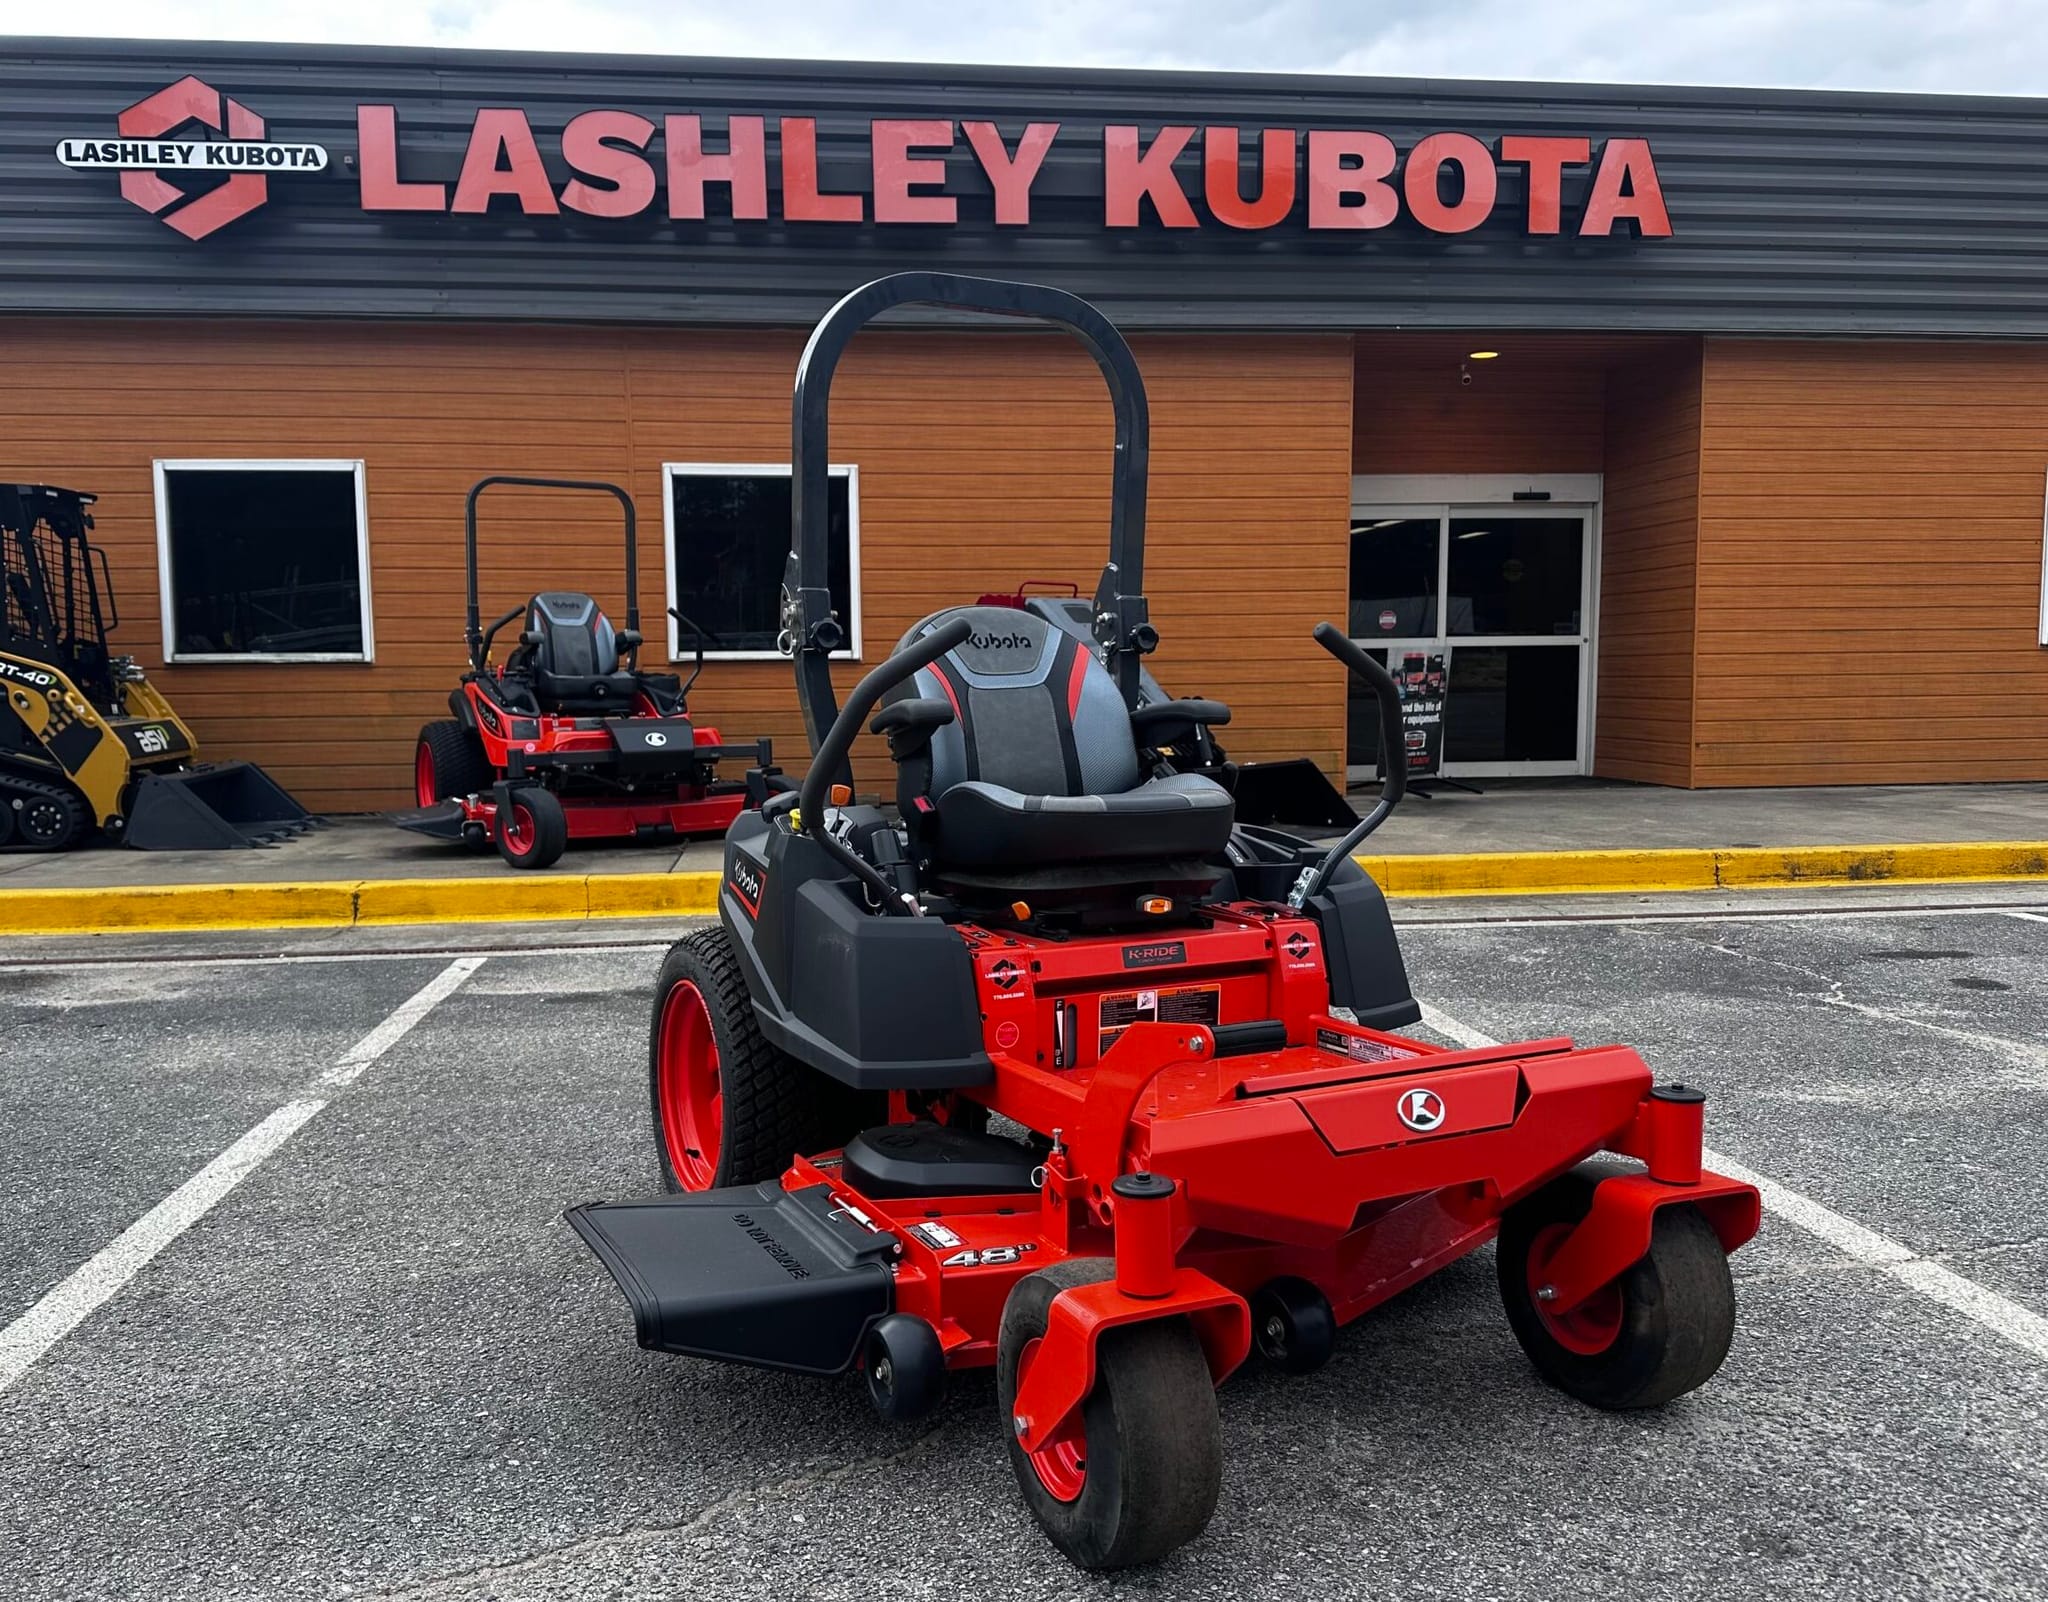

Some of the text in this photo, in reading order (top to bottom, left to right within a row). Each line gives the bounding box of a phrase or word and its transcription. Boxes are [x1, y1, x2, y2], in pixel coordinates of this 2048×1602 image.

[64, 142, 321, 167] LASHLEY KUBOTA
[356, 104, 1673, 236] LASHLEY KUBOTA
[966, 632, 1032, 649] Kubota
[734, 858, 759, 899] Kubota
[1129, 945, 1180, 960] K-RIDE
[1056, 1000, 1063, 1009] F
[1056, 1056, 1062, 1065] E
[731, 1211, 811, 1280] DO NOT REMOVE
